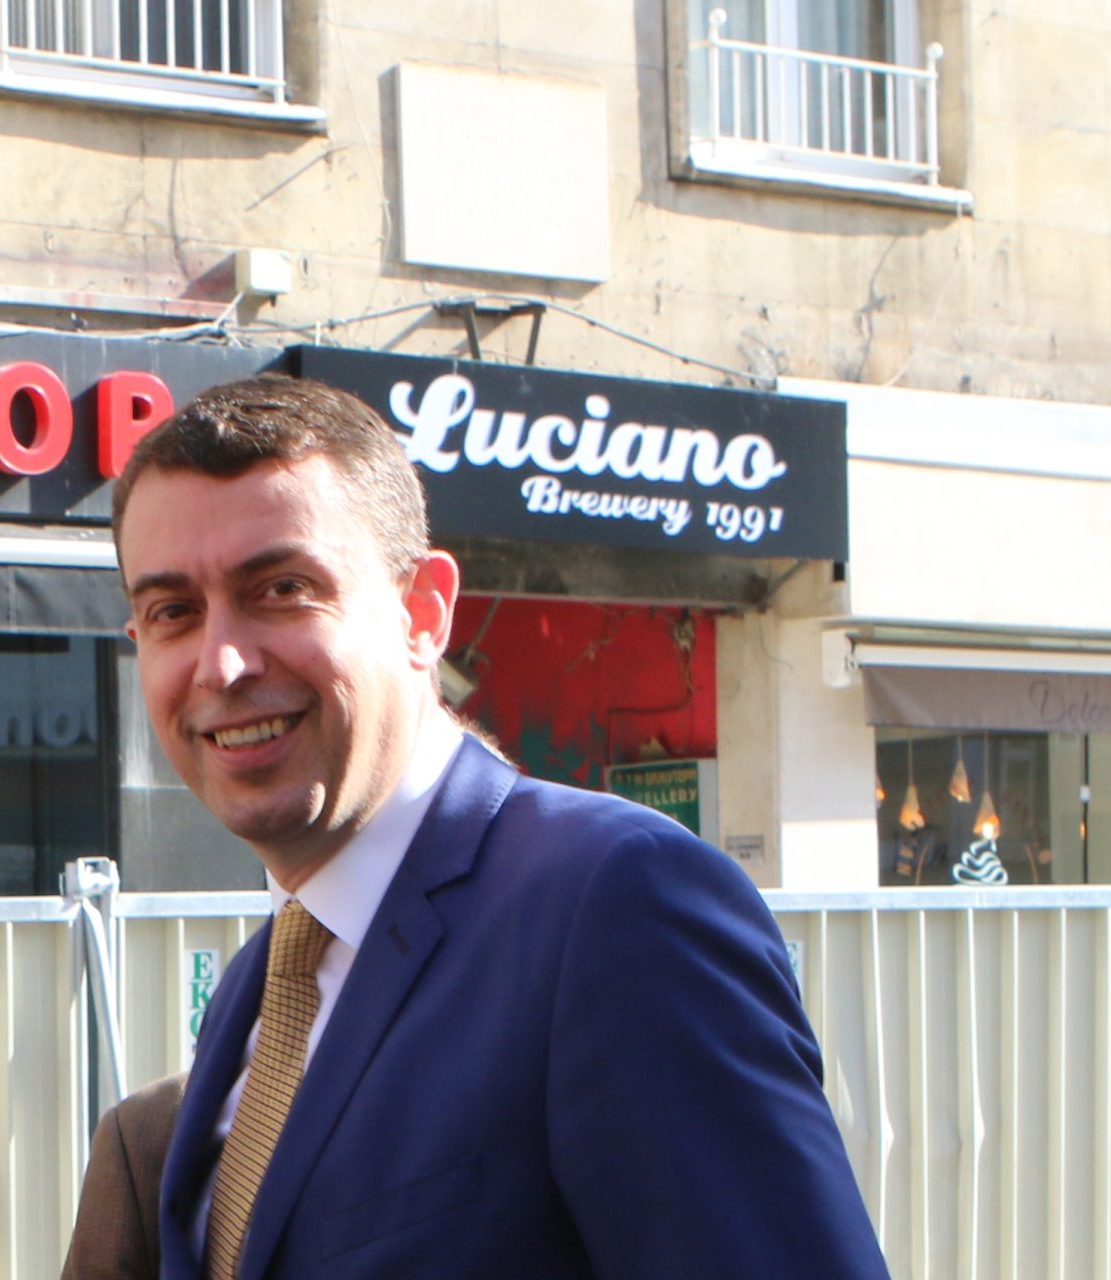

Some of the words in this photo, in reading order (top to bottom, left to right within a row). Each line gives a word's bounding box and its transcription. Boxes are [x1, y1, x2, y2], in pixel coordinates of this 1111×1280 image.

[389, 373, 787, 490] Luciano
[521, 475, 692, 536] Brewery
[706, 502, 783, 542] 1991
